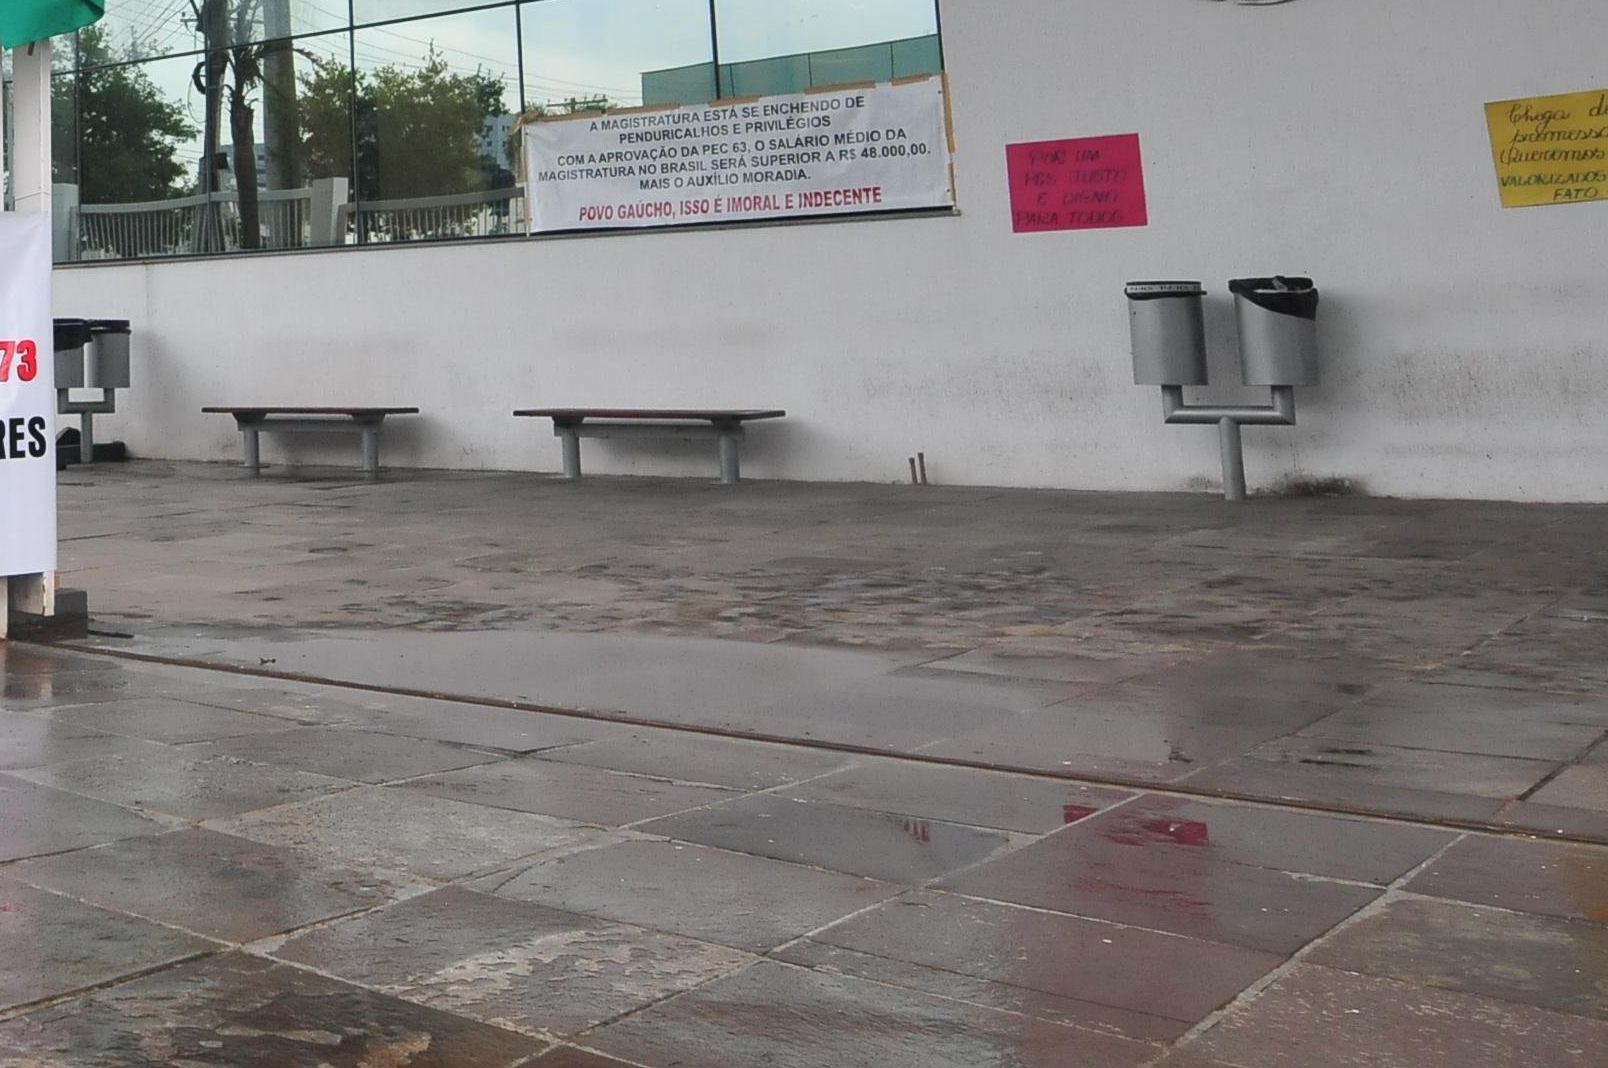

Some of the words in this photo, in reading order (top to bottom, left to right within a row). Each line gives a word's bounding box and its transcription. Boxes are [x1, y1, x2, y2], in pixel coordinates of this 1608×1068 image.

[589, 121, 598, 132] A
[601, 110, 700, 131] MAGISTRATURA
[704, 108, 738, 122] ESTÁ
[742, 105, 759, 118] SE
[764, 98, 841, 117] ENCHENDO
[845, 96, 865, 108] DE
[619, 125, 730, 144] PENDURICALHOS
[733, 123, 741, 134] E
[745, 115, 831, 133] PRIVILÉGIOS
[538, 166, 635, 181] MAGISTRATURA
[639, 164, 657, 175] NO
[661, 160, 706, 174] BRASIL
[711, 155, 747, 170] SERÁ
[751, 151, 821, 167] SUPERIOR
[825, 151, 835, 162] A
[839, 148, 857, 160] R$
[861, 143, 930, 159] 48.000,00.
[557, 154, 584, 166] COM
[587, 153, 596, 164] A
[598, 146, 678, 163] APROVAÇÃO
[681, 146, 699, 158] DA
[703, 143, 729, 156] PEC
[733, 141, 750, 154] 63,
[754, 140, 765, 151] O
[769, 134, 830, 150] SALÁRIO
[835, 129, 881, 145] MÉDIO
[886, 128, 907, 140] DA
[639, 177, 670, 190] MAIS
[674, 177, 683, 188] O
[687, 172, 739, 186] AUXÍLIO
[743, 169, 811, 183] MORADIA.
[1553, 187, 1598, 200] FATO
[579, 204, 613, 221] POVO
[617, 199, 676, 219] GAÚCHO,
[680, 199, 709, 215] ISSO
[714, 194, 722, 213] É
[727, 194, 780, 213] IMORAL
[785, 194, 794, 209] E
[799, 187, 882, 208] INDECENTE
